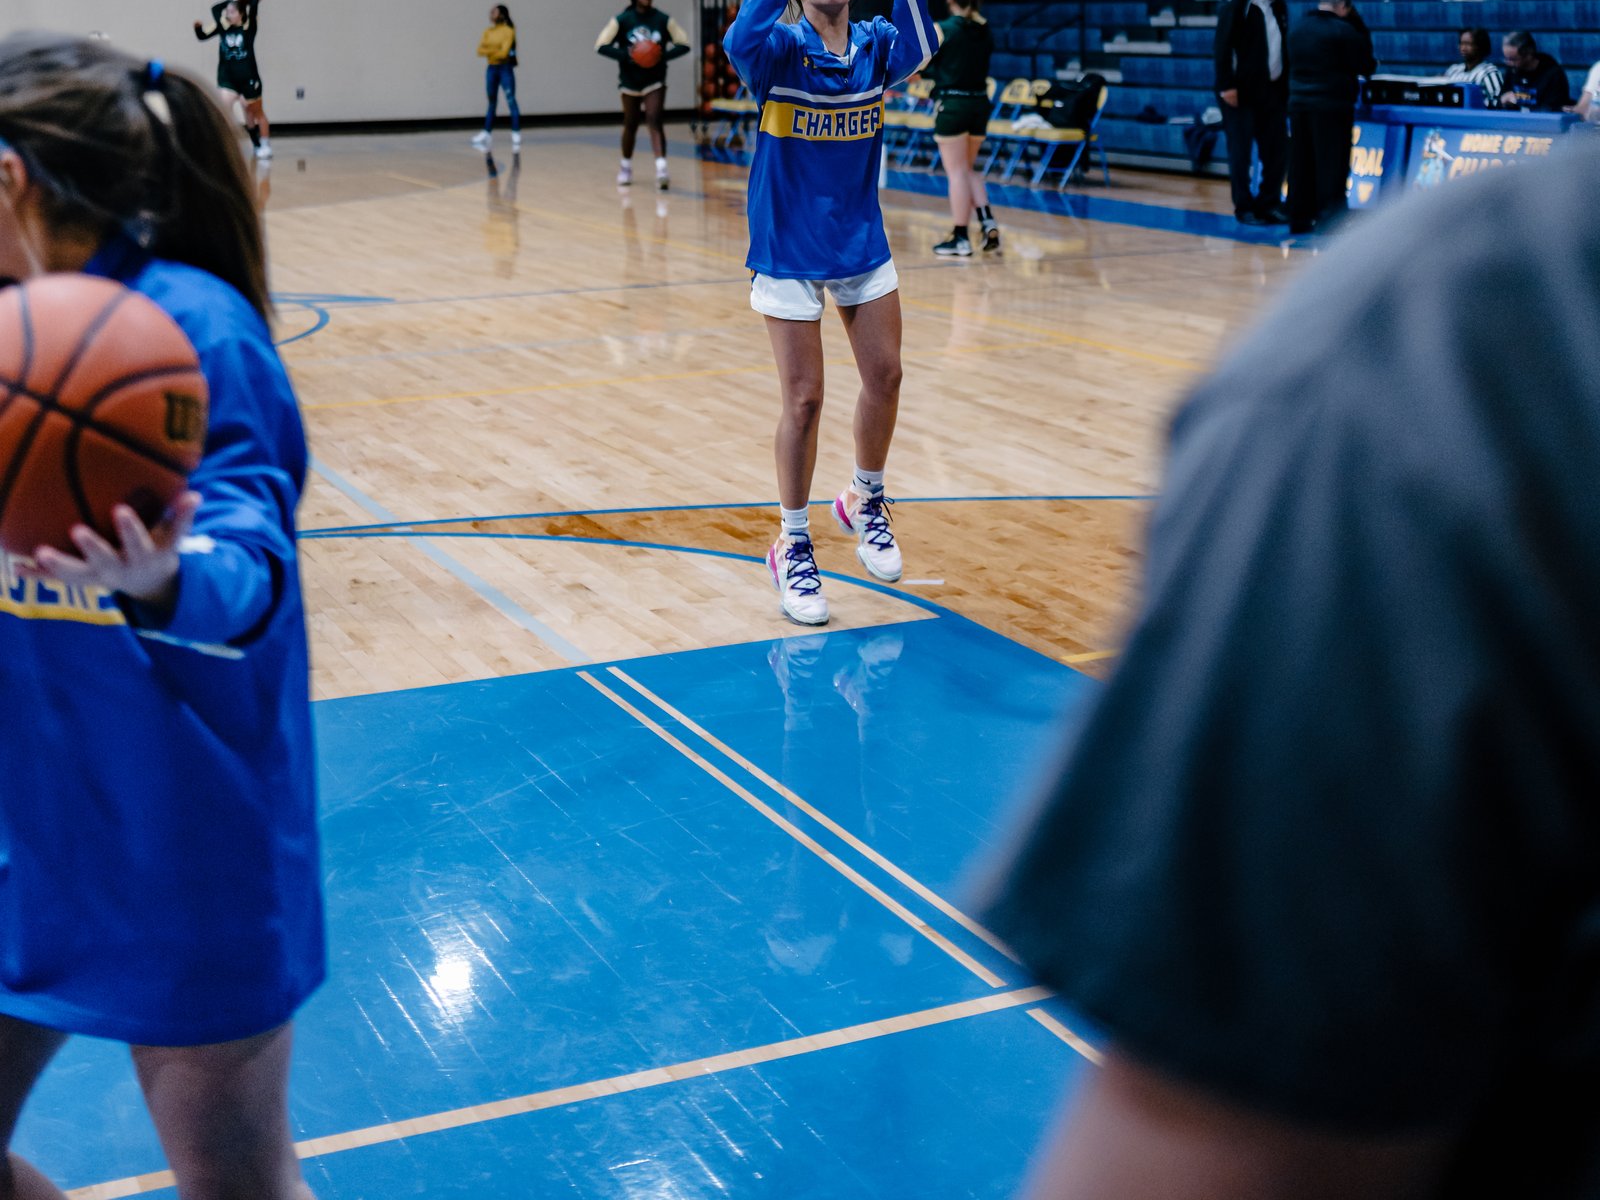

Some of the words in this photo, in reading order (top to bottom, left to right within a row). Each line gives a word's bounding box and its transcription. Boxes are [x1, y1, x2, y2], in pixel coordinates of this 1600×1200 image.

[792, 105, 881, 138] CHARGER
[1460, 133, 1503, 154] HOME
[1503, 135, 1523, 154] OF
